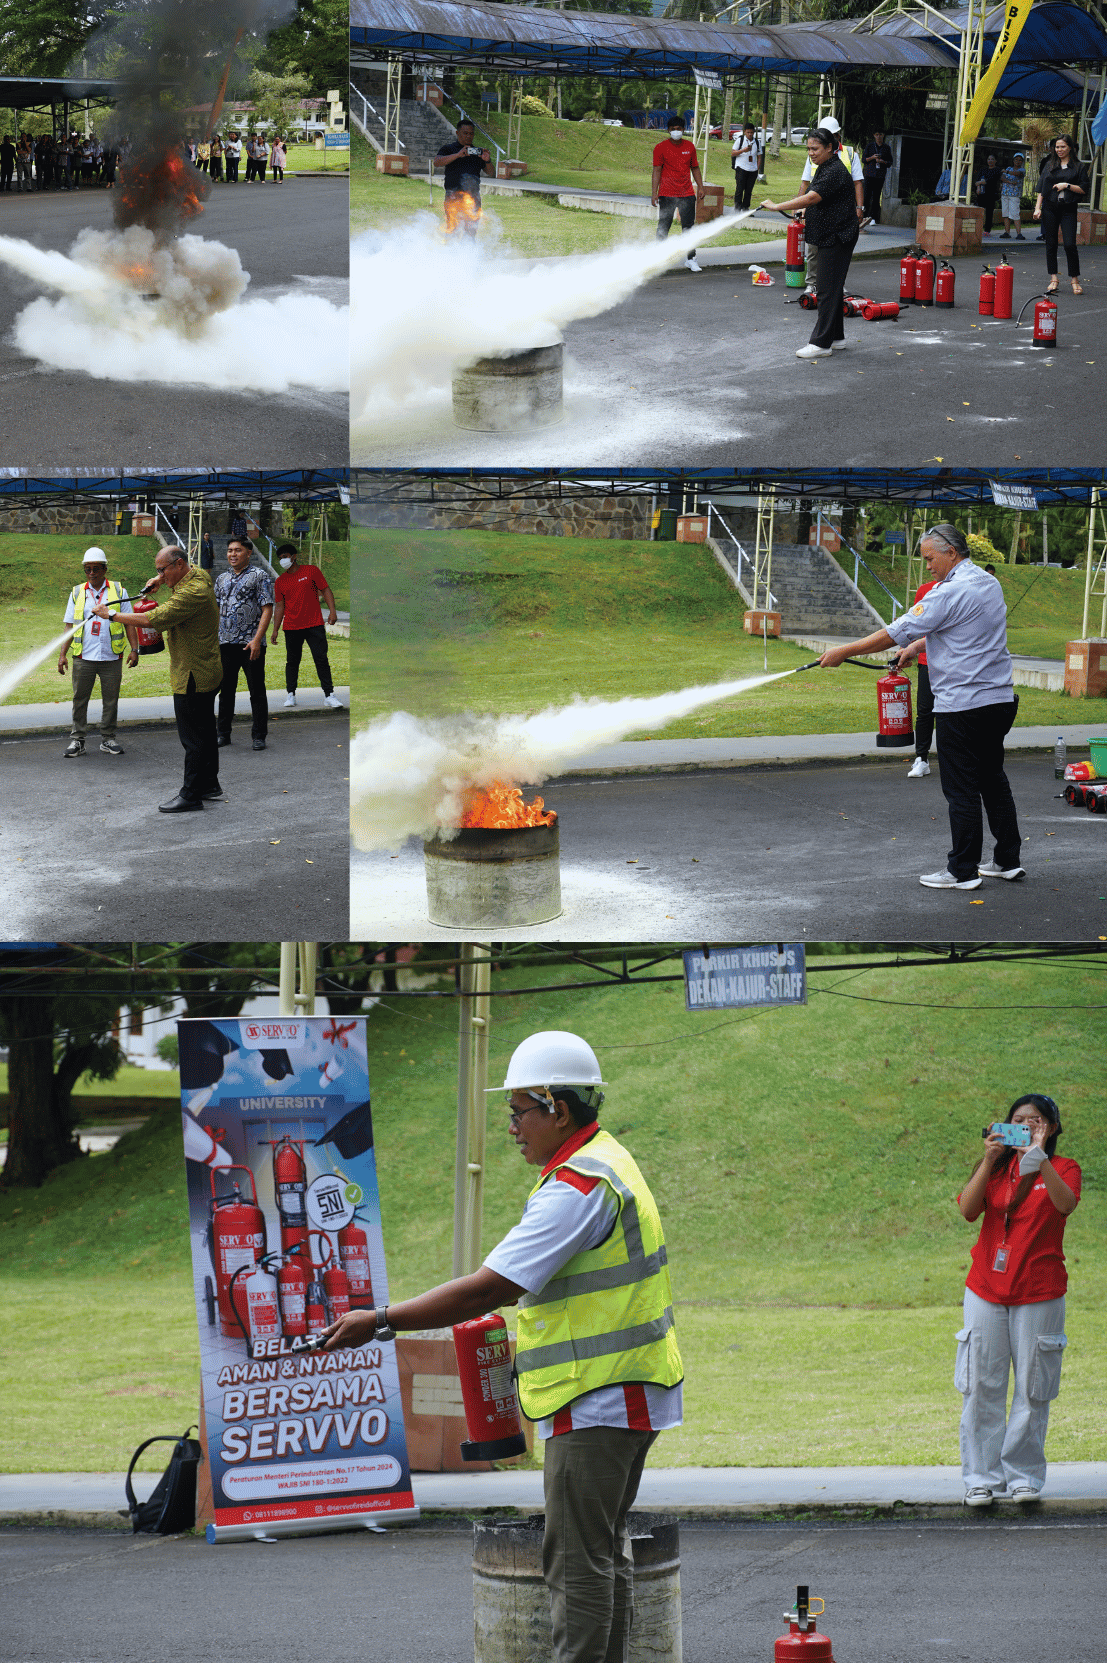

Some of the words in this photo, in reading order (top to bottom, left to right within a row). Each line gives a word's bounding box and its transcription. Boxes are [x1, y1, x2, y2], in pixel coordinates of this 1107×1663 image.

[881, 691, 907, 699] SERVO
[742, 950, 795, 968] KHUSUS
[688, 973, 802, 1004] DEKAN-KAJUR-STAFF
[239, 1096, 327, 1111] UNIVERSITY
[317, 1192, 344, 1215] SNI
[219, 1234, 254, 1245] SERVO
[340, 1245, 367, 1254] SERVO
[279, 1282, 305, 1291] SERVO
[249, 1291, 277, 1301] SERVO
[217, 1361, 279, 1386] AMAN
[280, 1359, 297, 1378] &
[298, 1348, 382, 1377] NYAMAN
[222, 1373, 385, 1422] BERSAMA
[219, 1408, 389, 1464] SERVVO
[229, 1475, 263, 1483] Peraturan
[263, 1472, 290, 1481] Menteri
[290, 1468, 335, 1478] Perindustrian
[356, 1465, 376, 1473] Tahun
[376, 1462, 393, 1471] 2024
[277, 1481, 298, 1489] WAJIB
[299, 1480, 311, 1488] SNI
[312, 1477, 349, 1486] 180-1:2022
